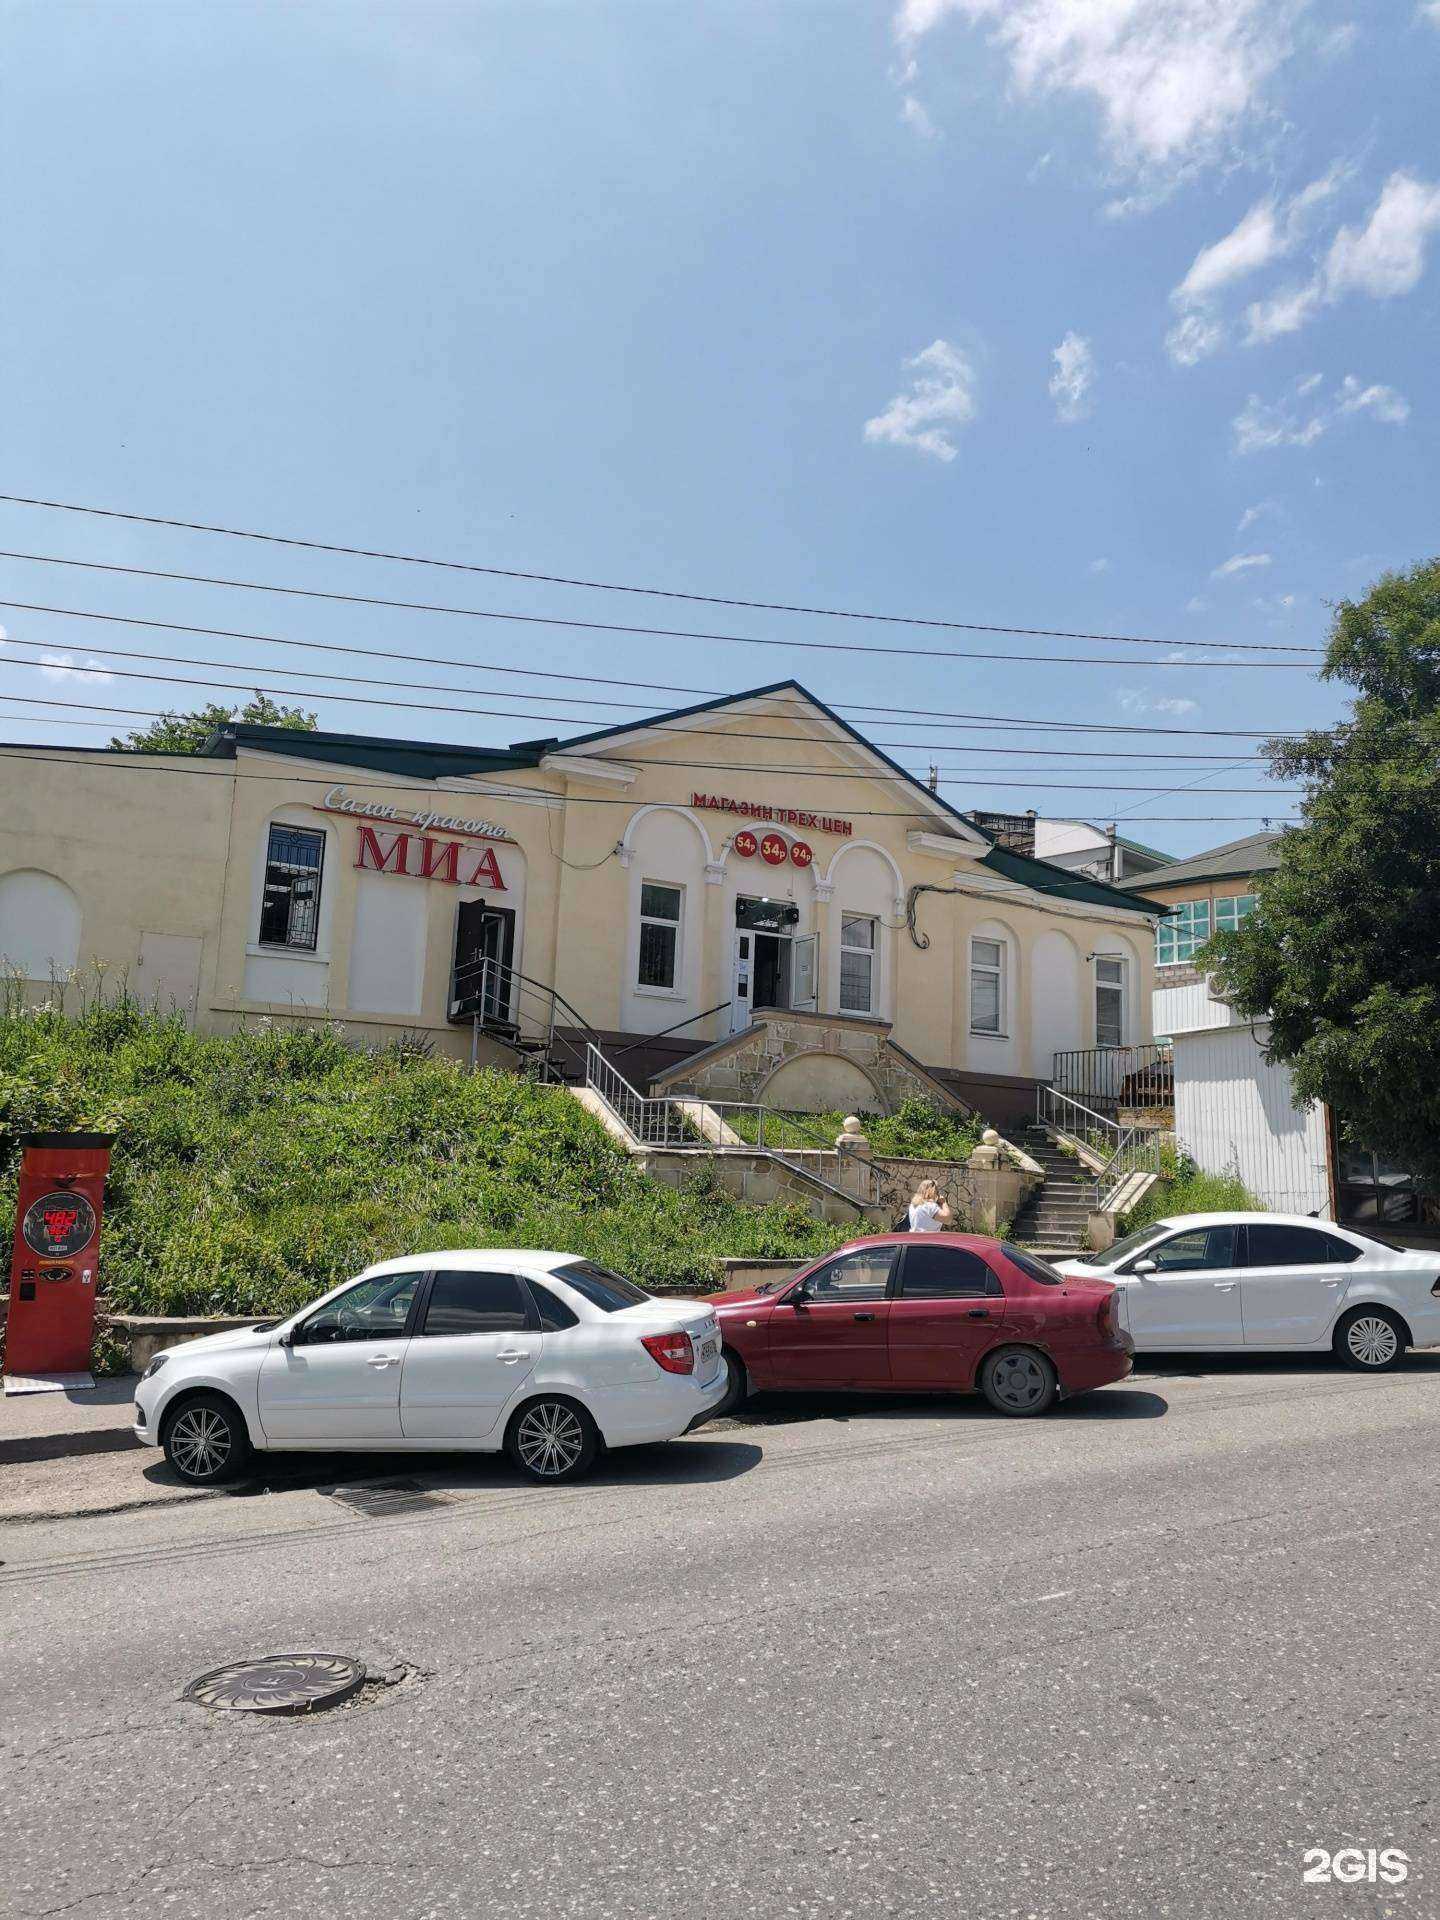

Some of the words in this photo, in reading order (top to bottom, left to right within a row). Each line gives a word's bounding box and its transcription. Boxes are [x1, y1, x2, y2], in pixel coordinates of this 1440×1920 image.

[324, 785, 400, 819] Салон
[691, 791, 773, 820] МАГАЗИН
[775, 808, 818, 829] ТРЕХ
[822, 816, 853, 836] ЦЕН
[353, 826, 509, 891] МИА
